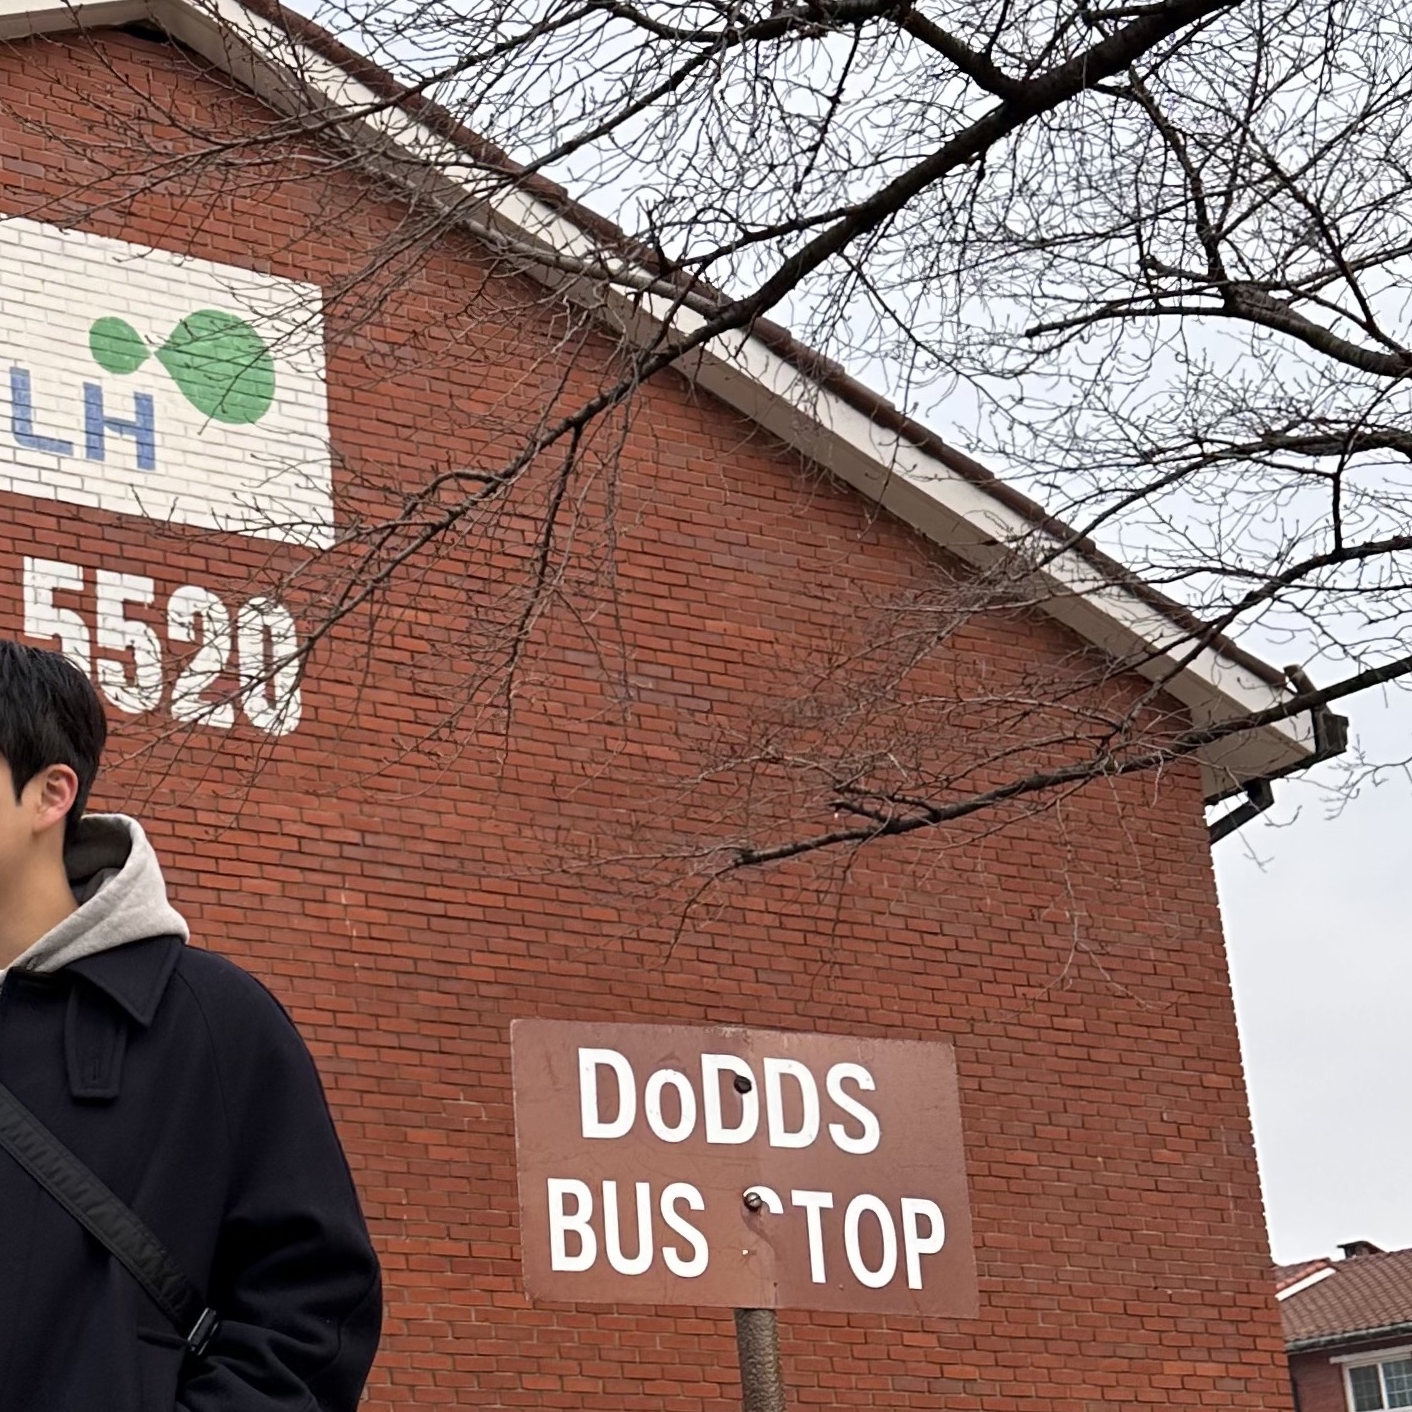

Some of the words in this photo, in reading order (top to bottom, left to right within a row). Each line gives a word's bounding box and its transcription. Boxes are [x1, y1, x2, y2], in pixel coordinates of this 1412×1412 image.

[9, 365, 156, 471] LH
[22, 555, 303, 737] 5520
[577, 1046, 881, 1156] DoDDS
[547, 1176, 710, 1279] BUS
[743, 1185, 946, 1291] TOP
